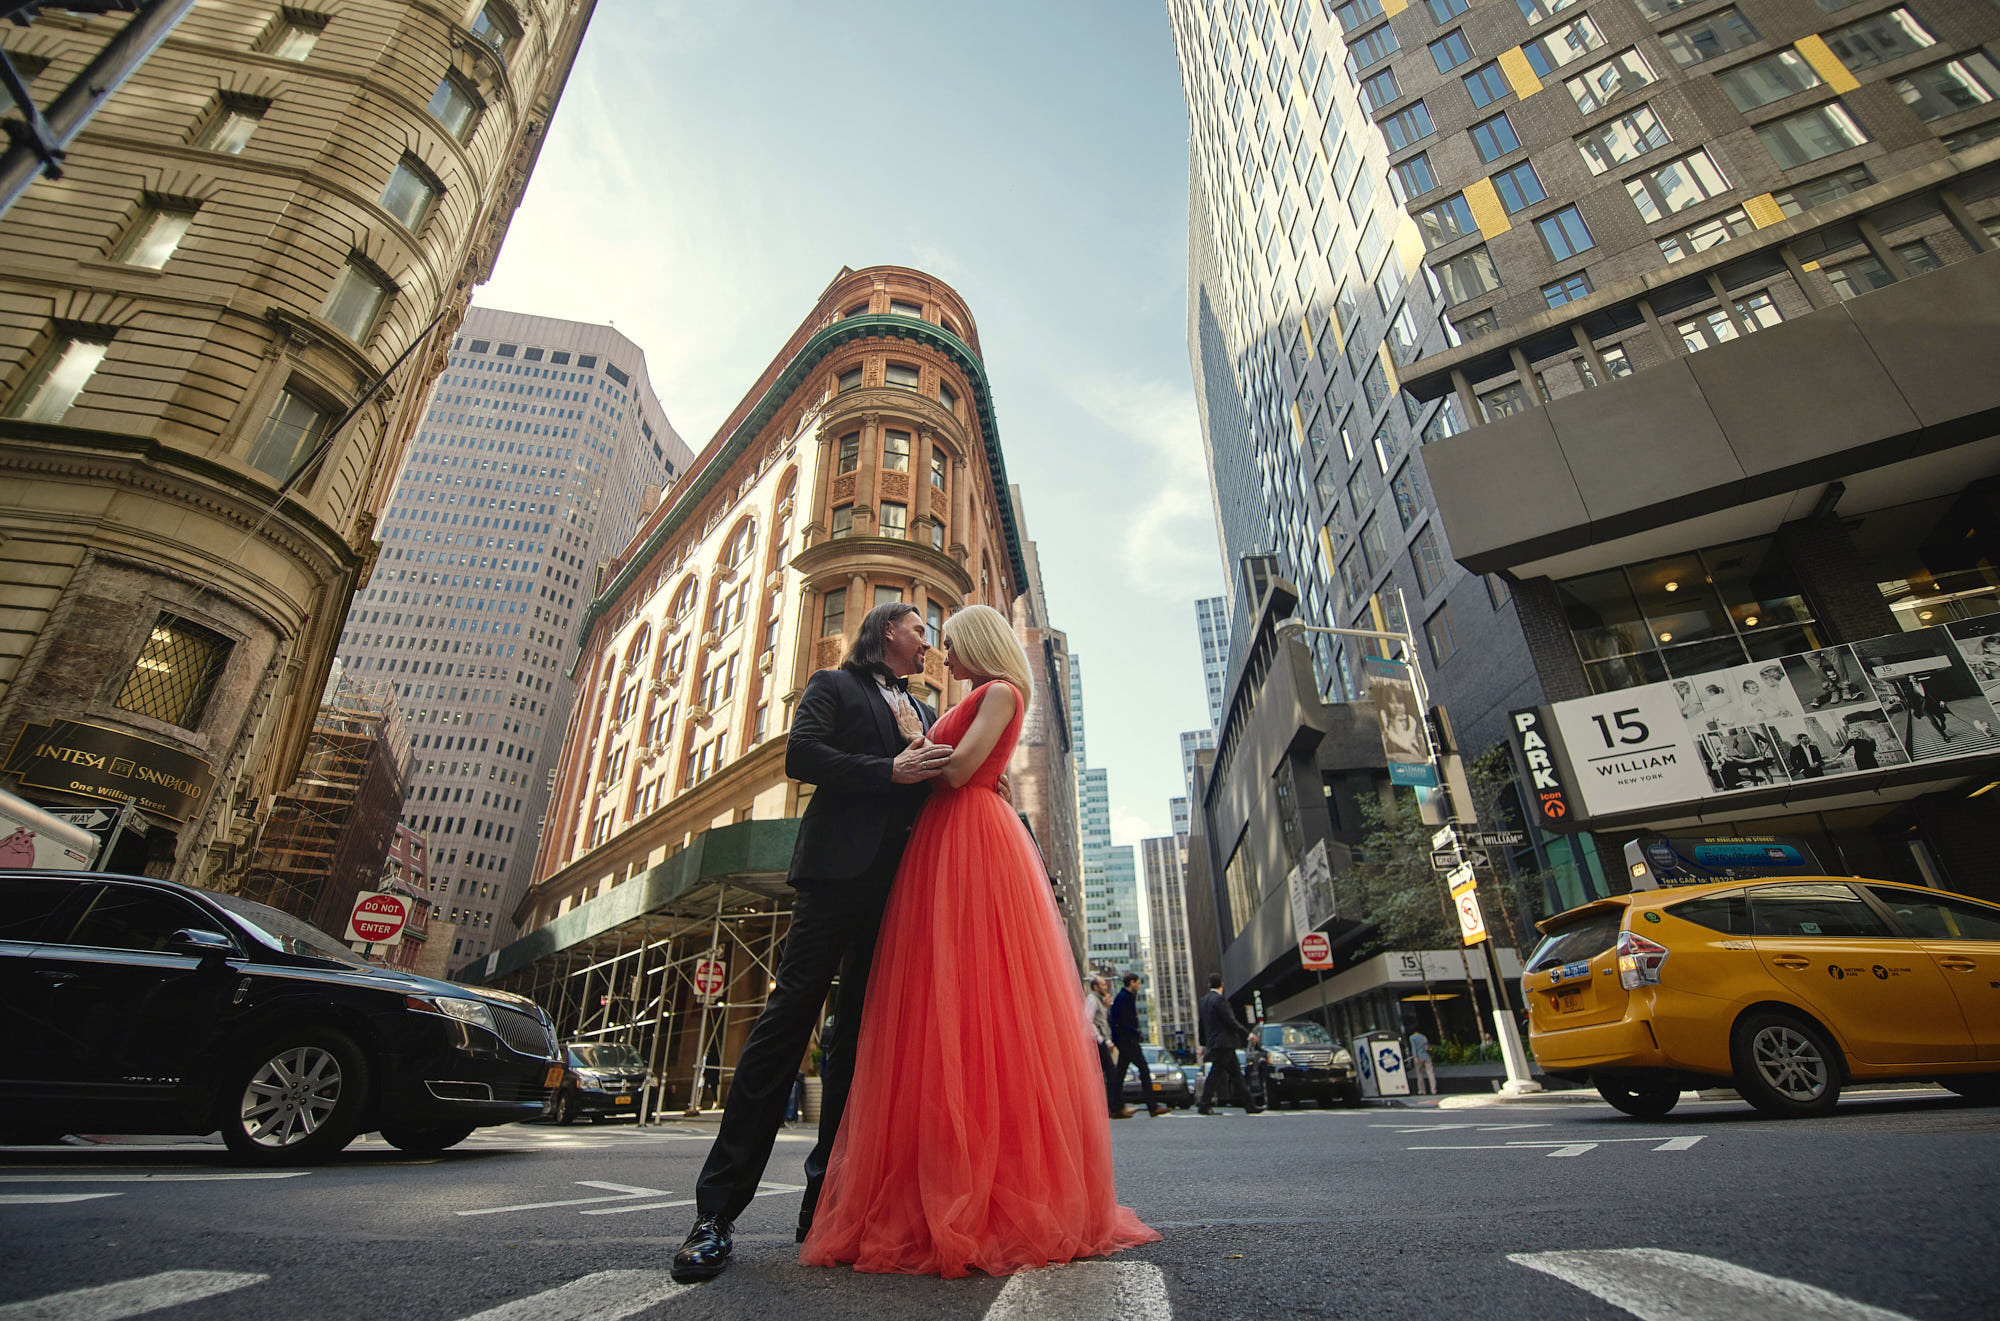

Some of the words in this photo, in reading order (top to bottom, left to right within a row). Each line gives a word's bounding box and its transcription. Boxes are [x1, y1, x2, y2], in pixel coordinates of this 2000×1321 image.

[1591, 708, 1650, 749] 15
[1515, 712, 1559, 790] PARK
[35, 743, 106, 770] INTESA
[135, 766, 201, 800] SANPAOLO
[1596, 754, 1677, 777] WILLIAM
[1617, 777, 1638, 785] NEW
[1641, 773, 1664, 782] YORK
[70, 780, 94, 793] One
[97, 786, 136, 802] William
[139, 797, 166, 811] Street
[69, 814, 94, 823] WAY
[1483, 833, 1519, 846] WILLIAM
[1704, 851, 1767, 863] Eyewitness
[365, 902, 378, 911] DO
[380, 904, 400, 913] NOT
[360, 922, 391, 934] ENTER
[1401, 956, 1416, 968] 15
